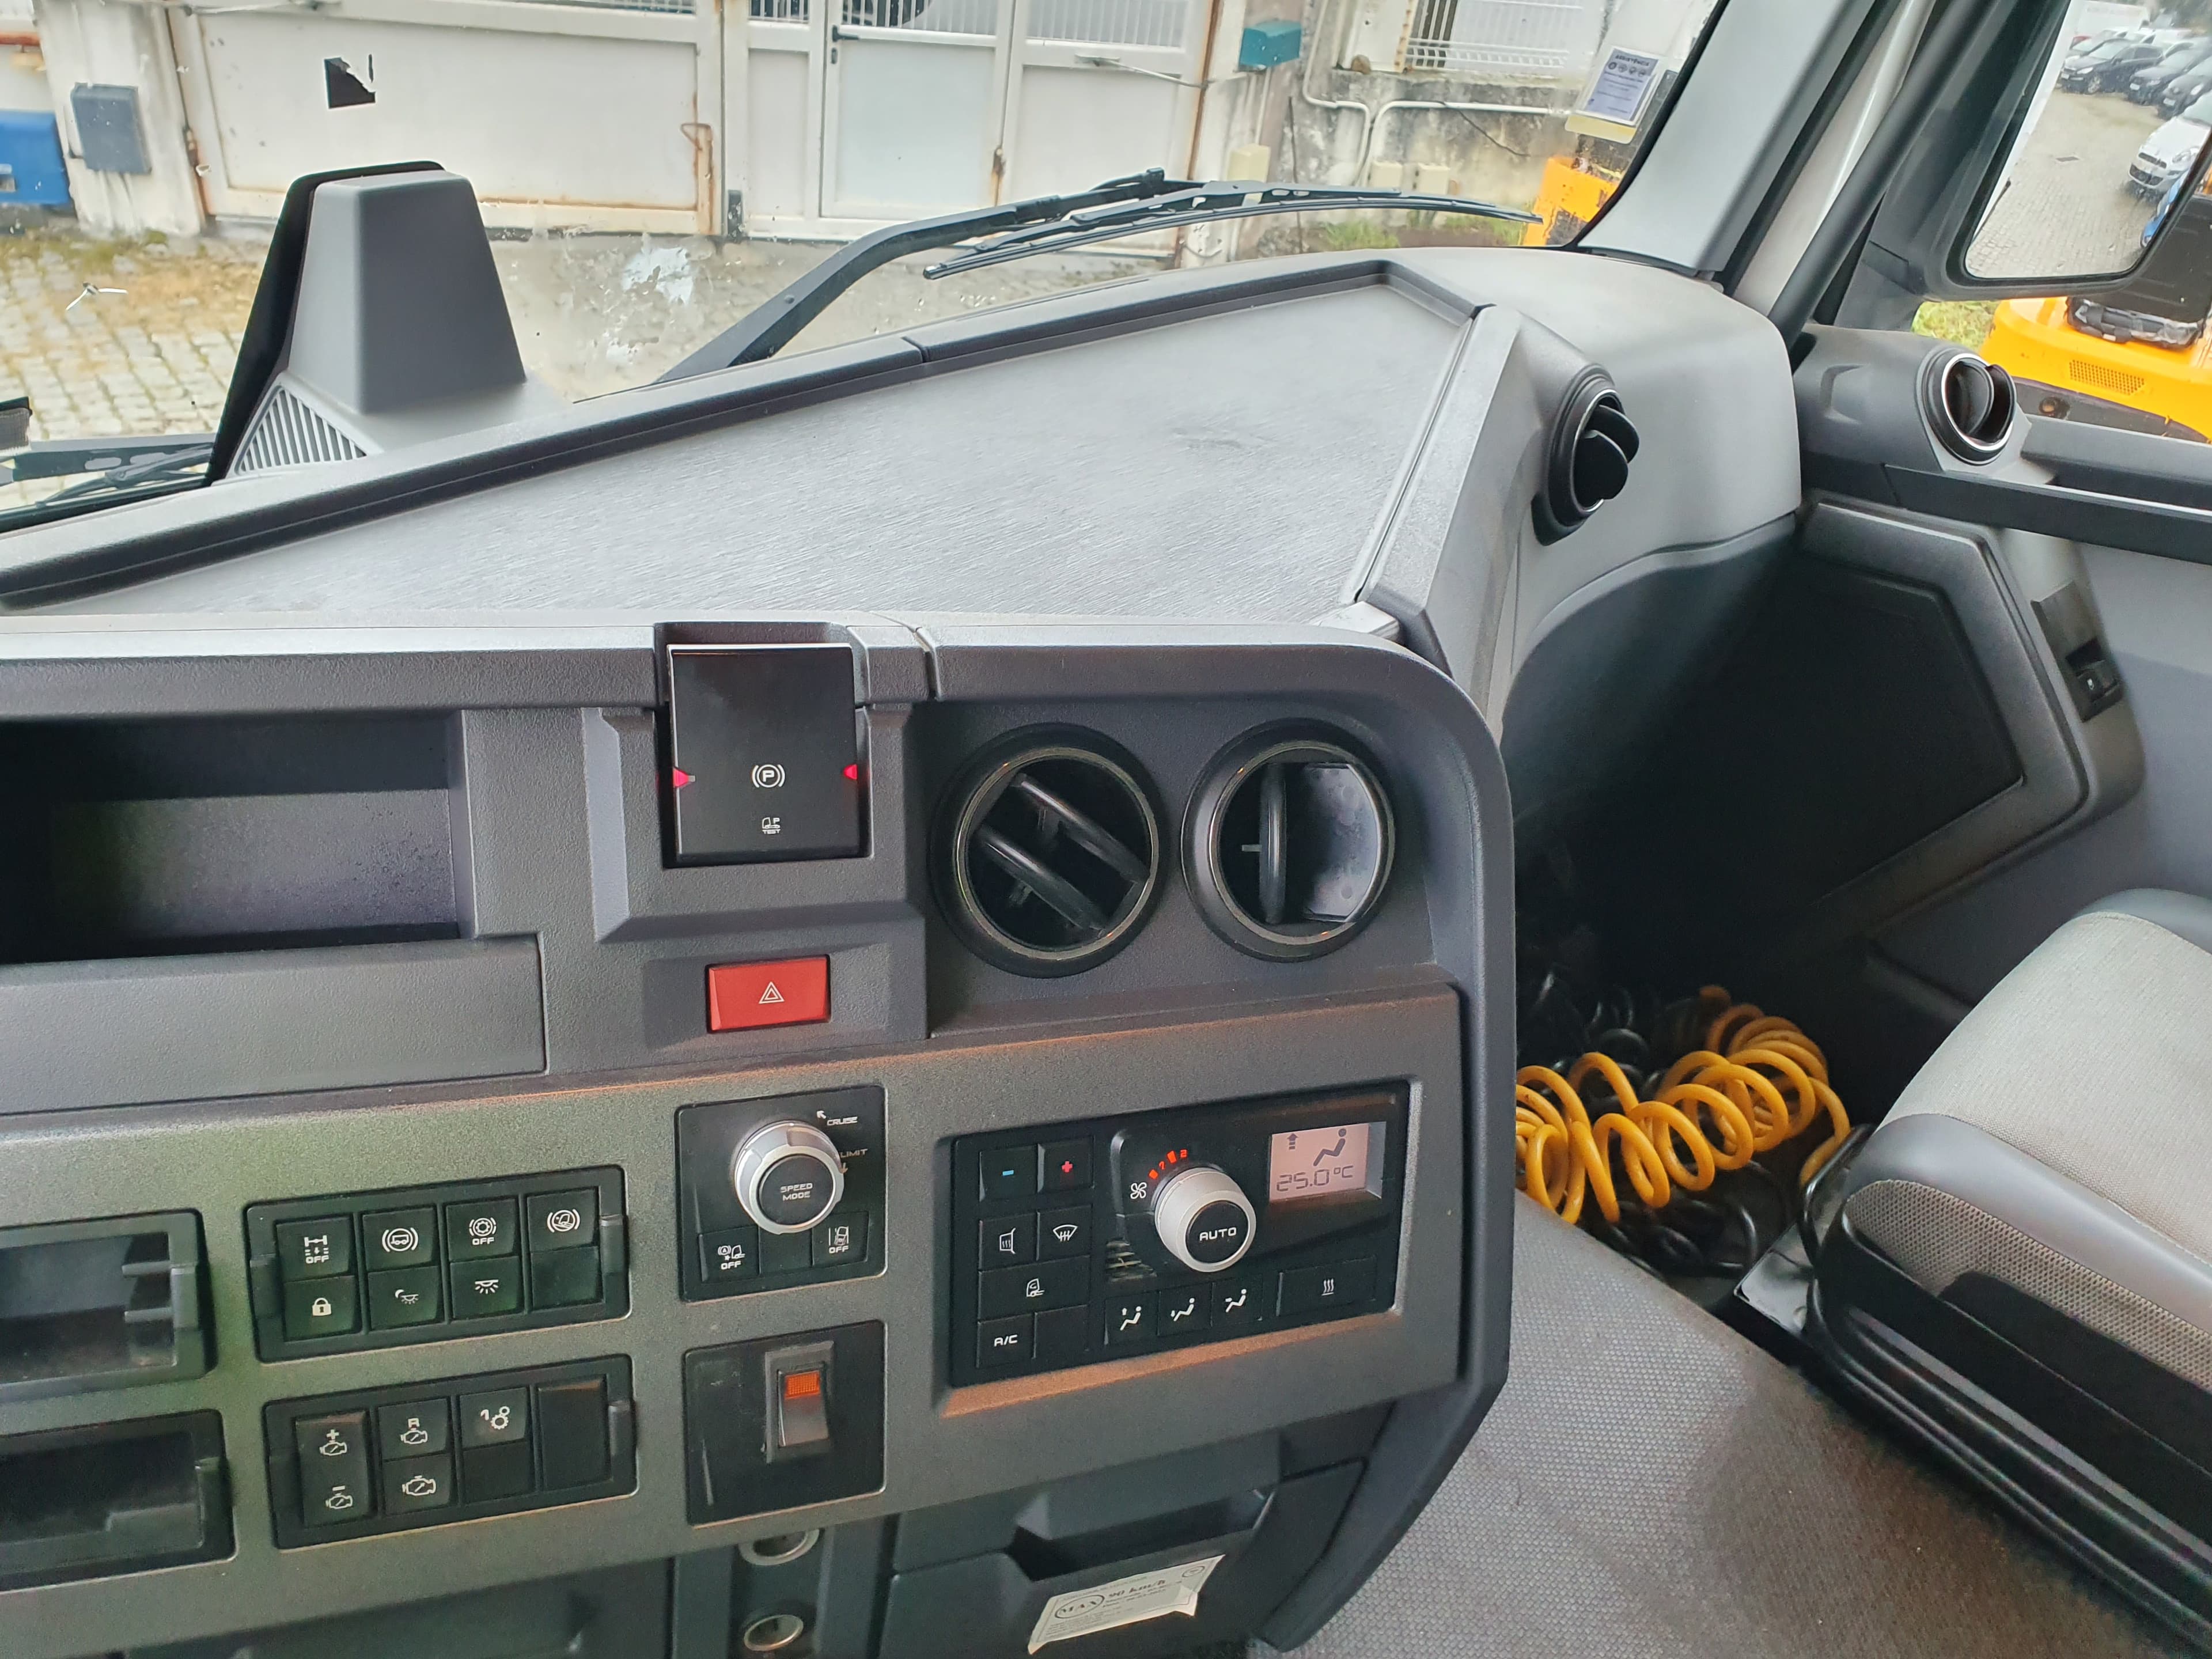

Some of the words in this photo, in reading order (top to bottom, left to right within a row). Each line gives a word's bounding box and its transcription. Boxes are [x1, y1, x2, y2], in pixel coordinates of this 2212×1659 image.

[762, 770, 775, 782] P
[827, 1116, 858, 1126] CRUISE
[840, 1148, 869, 1158] LIMIT
[1179, 1149, 1188, 1158] 2
[780, 1182, 813, 1194] SPEED
[782, 1190, 811, 1202] MODE
[1199, 1226, 1237, 1243] AUTO
[472, 1237, 495, 1246] OFF
[828, 1245, 850, 1254] OFF
[305, 1253, 329, 1264] OFF
[720, 1260, 742, 1270] OFF
[994, 1334, 1018, 1347] A/C
